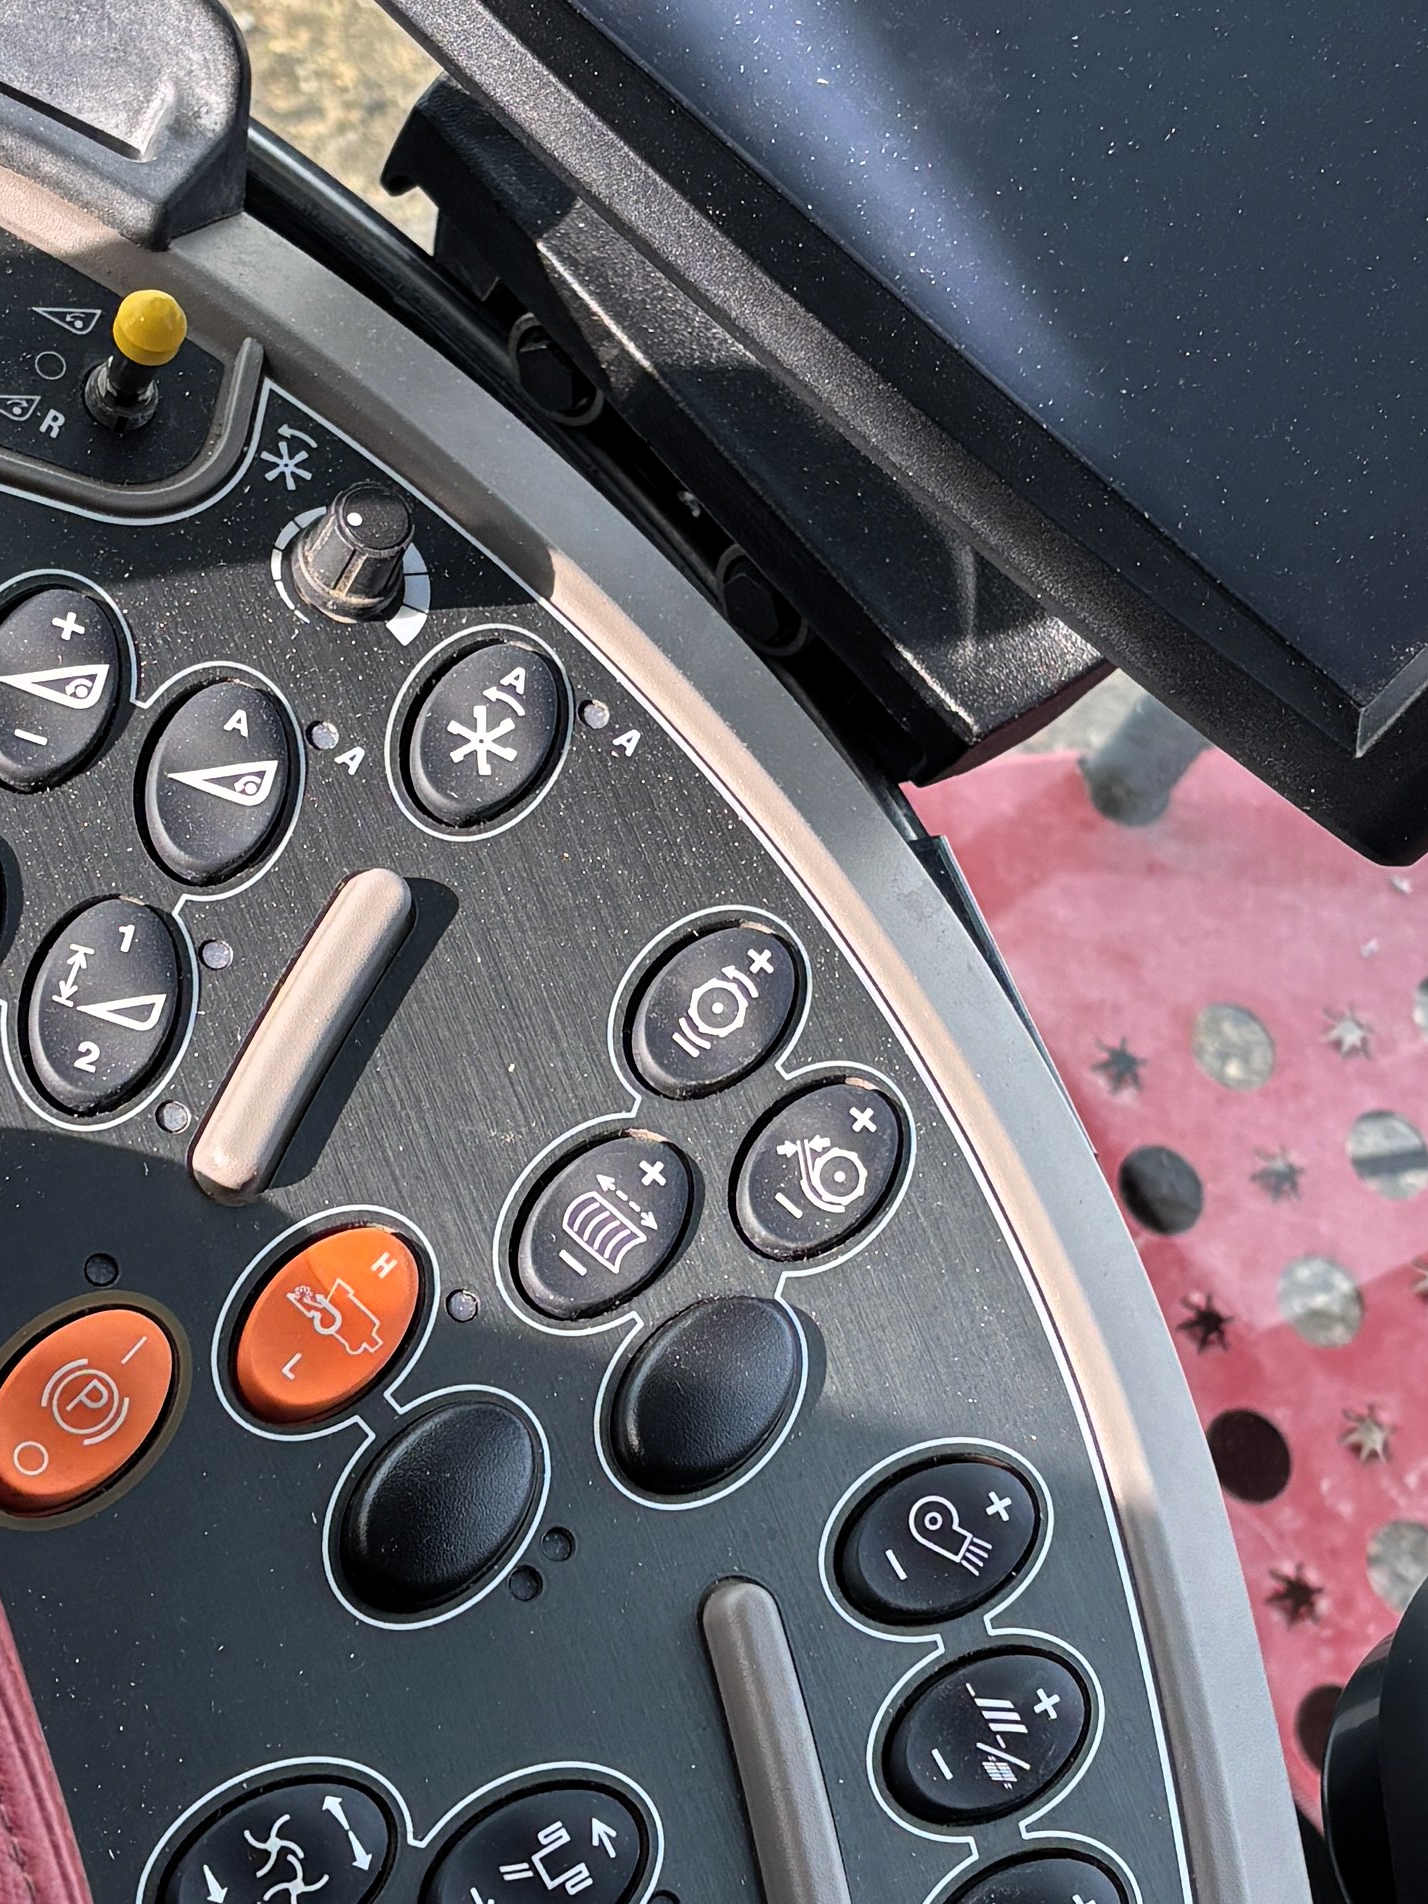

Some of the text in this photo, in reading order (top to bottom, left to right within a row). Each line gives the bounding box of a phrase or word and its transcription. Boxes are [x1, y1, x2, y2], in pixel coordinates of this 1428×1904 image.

[38, 408, 67, 440] R
[501, 665, 529, 696] A
[222, 708, 250, 739] A
[612, 728, 643, 757] A
[334, 745, 366, 776] A
[117, 924, 137, 954] 1
[73, 1040, 101, 1074] 2
[370, 1252, 399, 1279] H
[281, 1352, 303, 1380] L
[65, 1378, 109, 1413] P
